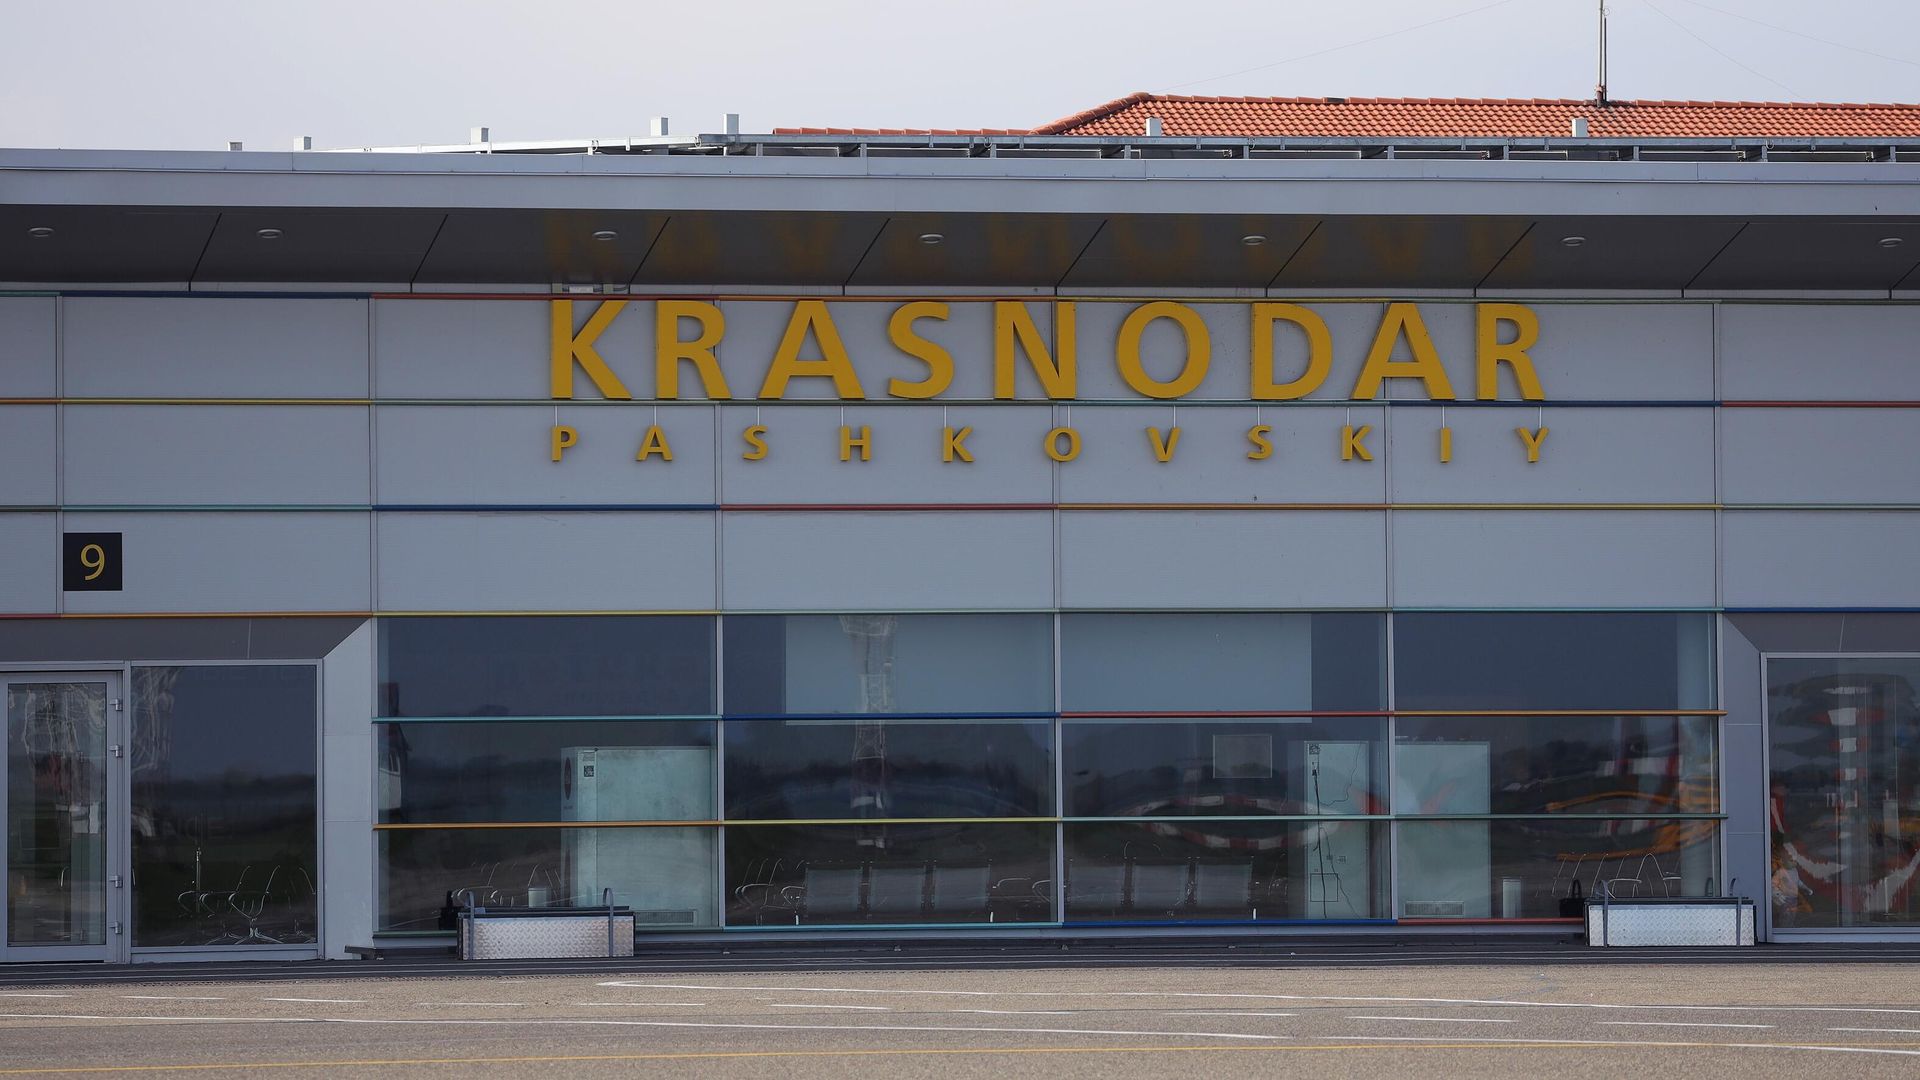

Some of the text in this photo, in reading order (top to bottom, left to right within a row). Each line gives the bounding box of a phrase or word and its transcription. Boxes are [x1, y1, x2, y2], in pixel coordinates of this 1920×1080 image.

[550, 299, 1545, 401] KRASNODAR
[551, 425, 1549, 463] PASHKOVSKIY
[80, 543, 106, 581] 9
